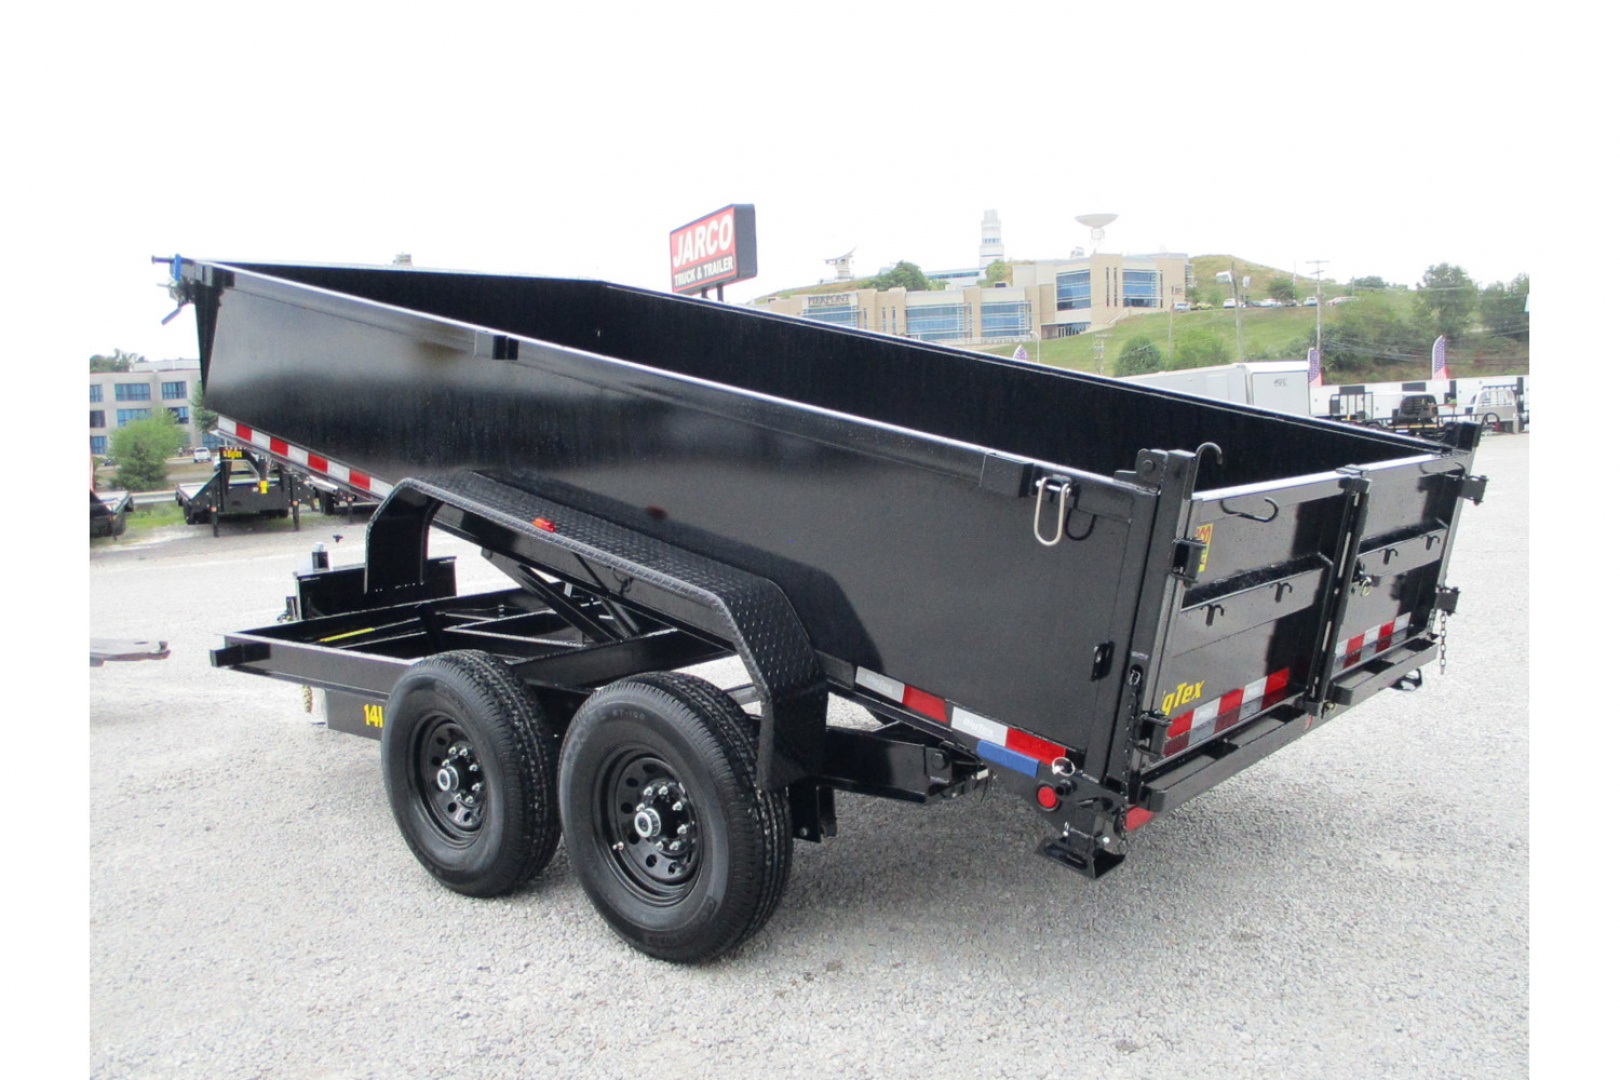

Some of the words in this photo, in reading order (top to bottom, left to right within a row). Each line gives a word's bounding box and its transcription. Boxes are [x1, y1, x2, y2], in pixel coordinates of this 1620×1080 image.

[673, 214, 734, 268] JARCO
[674, 268, 696, 287] TRUCK
[697, 267, 703, 280] &
[703, 256, 734, 278] TRAILER
[1161, 680, 1206, 716] gTex
